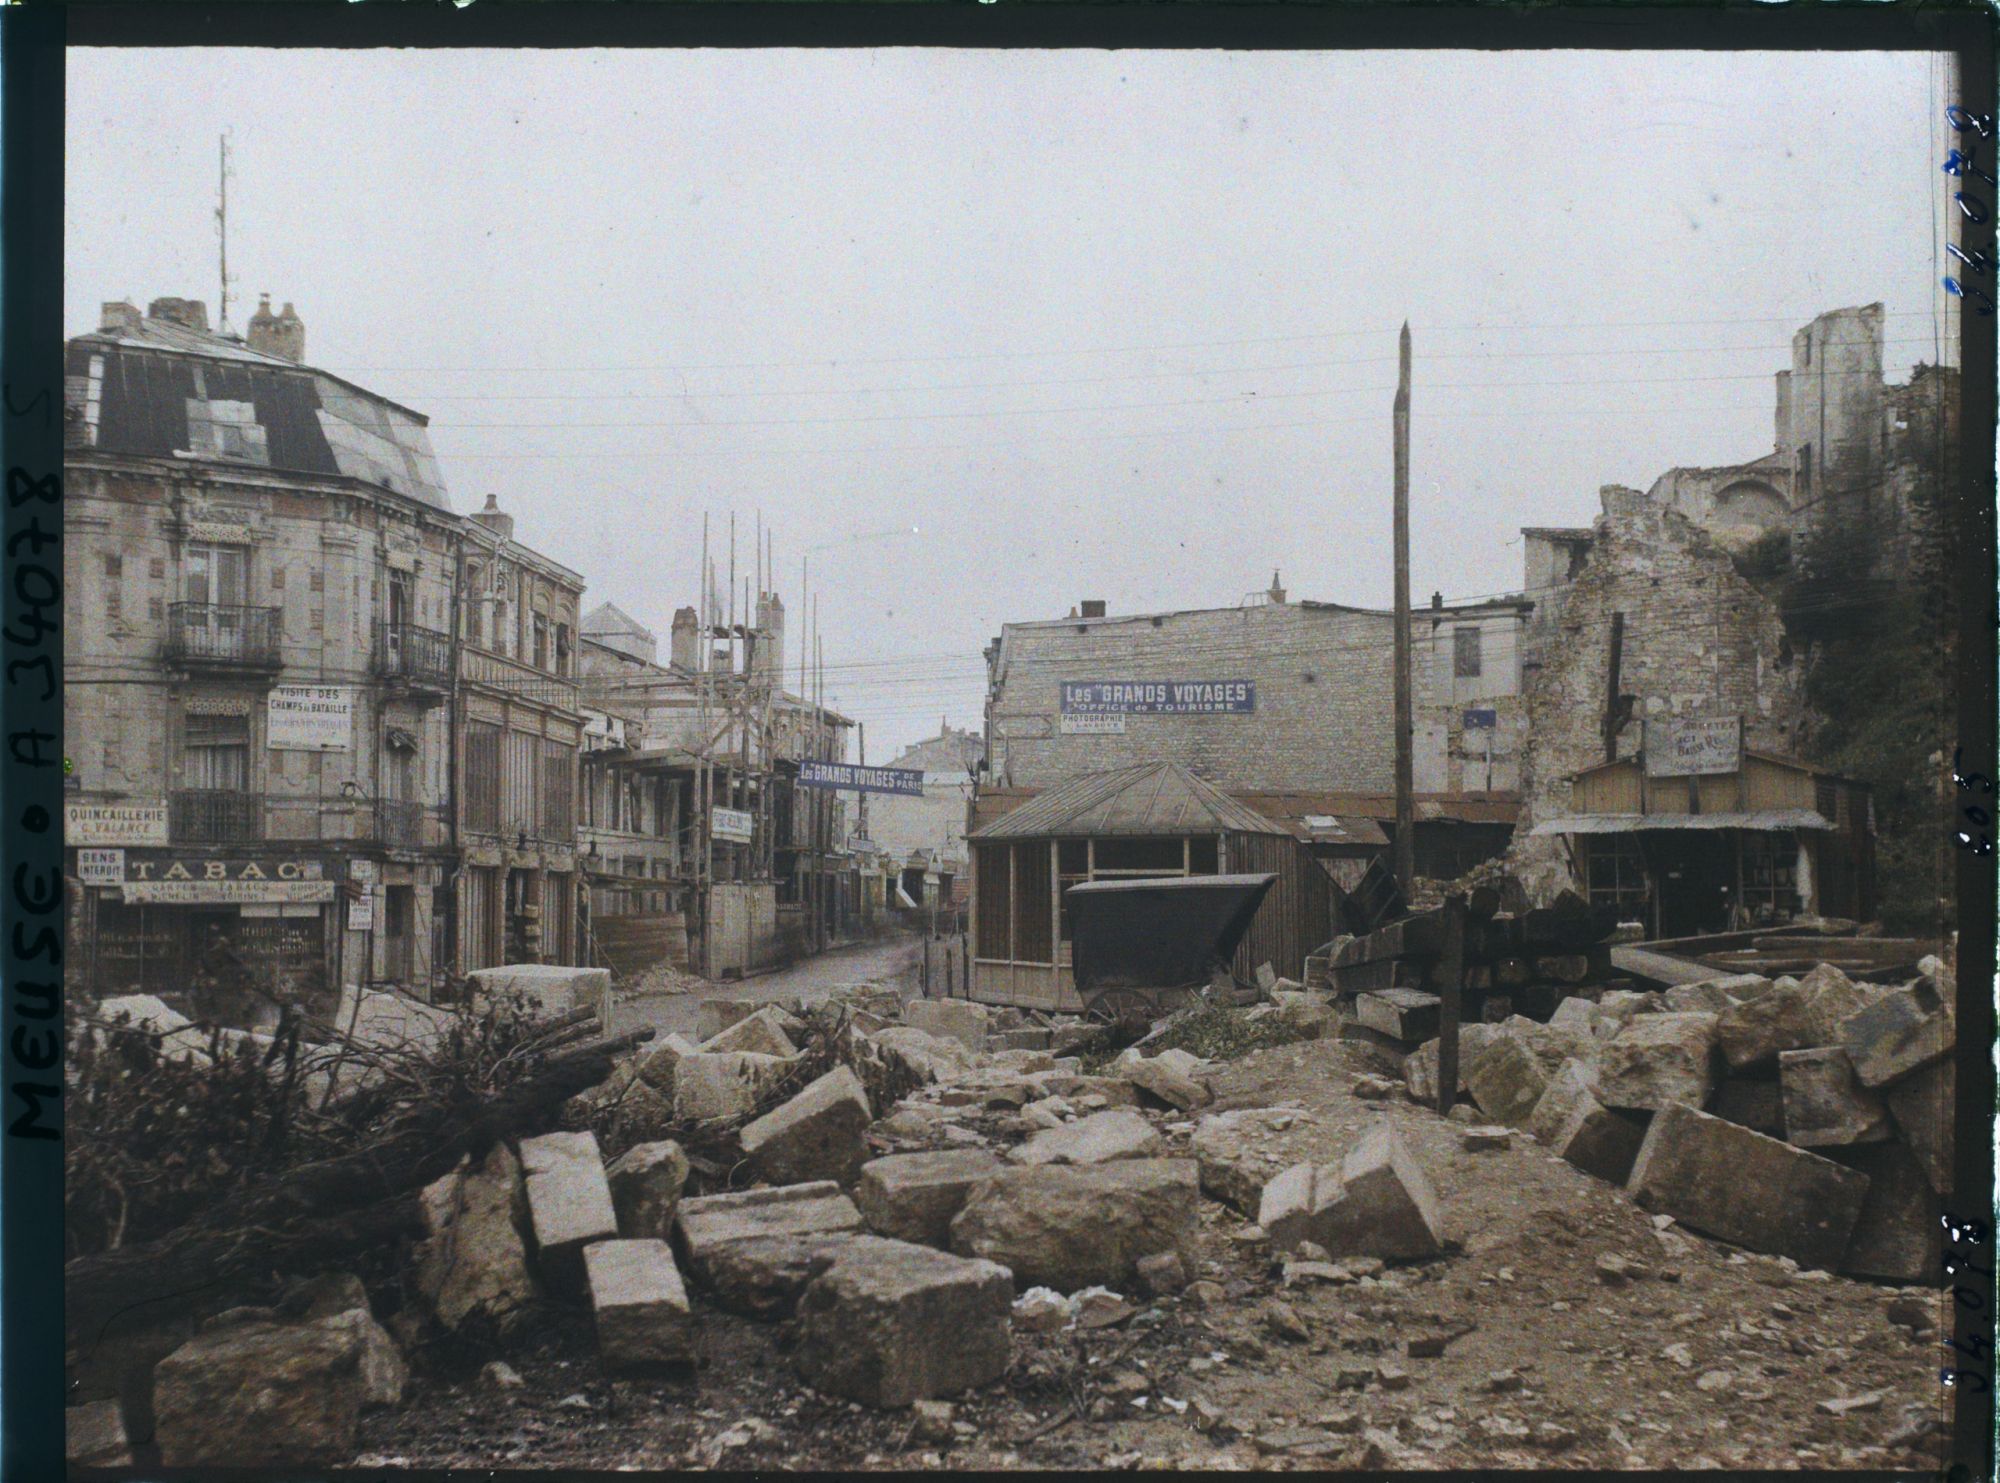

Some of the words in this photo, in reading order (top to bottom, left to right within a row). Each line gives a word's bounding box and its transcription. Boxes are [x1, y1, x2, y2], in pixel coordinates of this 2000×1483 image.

[3, 466, 60, 701] 34078
[279, 687, 312, 698] VISITE
[318, 688, 340, 700] DES
[1066, 685, 1091, 703] Les
[271, 699, 303, 712] CHAMPS
[312, 703, 348, 715] BATAILLE
[1156, 703, 1234, 711] TOURISME
[1062, 714, 1123, 722] PHOTOGRAPHIE
[8, 728, 57, 768] A
[896, 780, 922, 791] PARIS
[70, 809, 164, 821] QUINCAILLERIE
[82, 852, 116, 863] SENS
[79, 865, 121, 876] INTERDIT
[8, 862, 62, 1142] MEUSE
